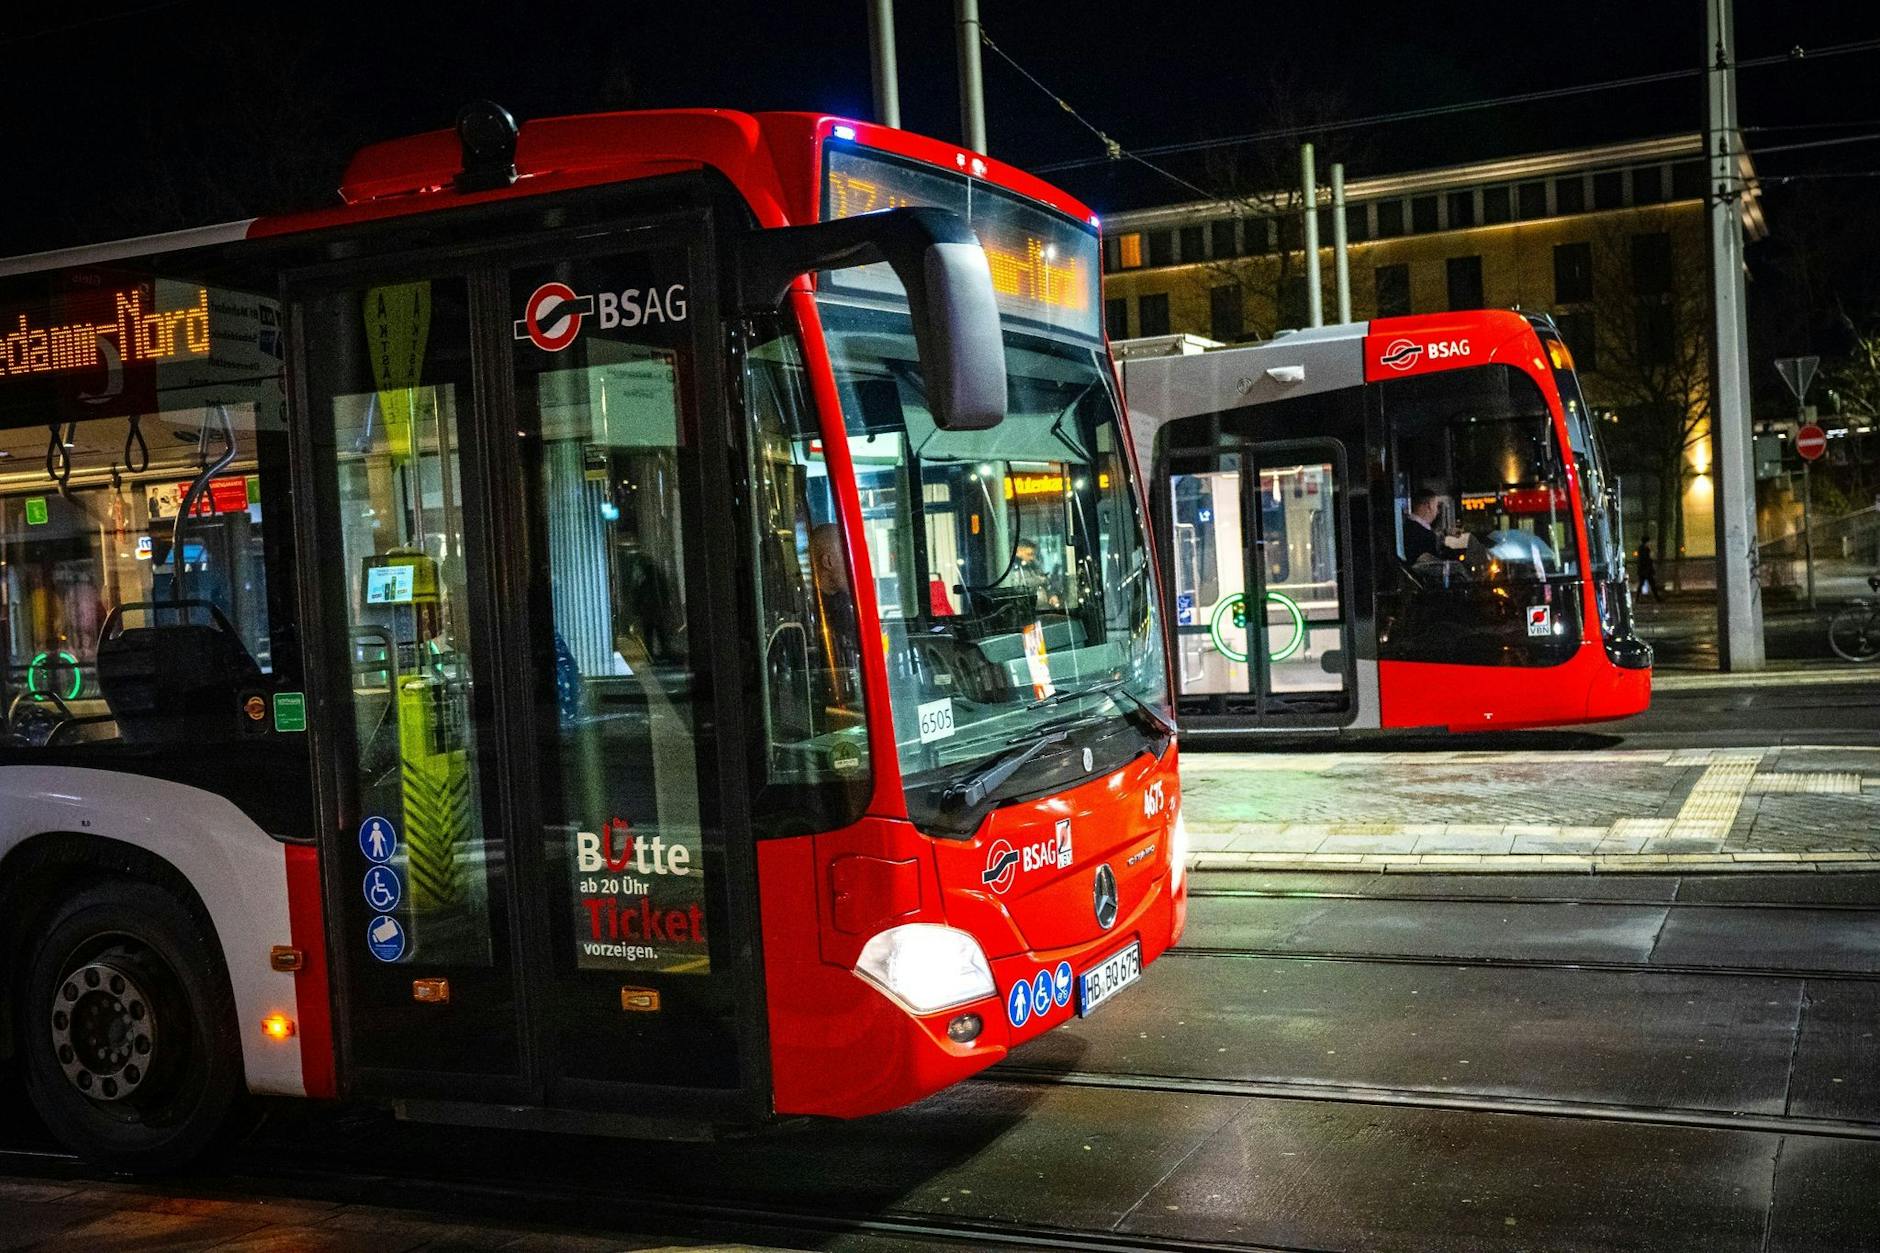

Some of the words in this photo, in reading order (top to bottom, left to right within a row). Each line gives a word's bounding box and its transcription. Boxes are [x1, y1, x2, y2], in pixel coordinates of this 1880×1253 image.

[599, 284, 687, 329] BSAG
[1428, 339, 1471, 360] BSAG
[1530, 625, 1550, 635] VBN
[921, 709, 953, 734] 6505
[1023, 838, 1056, 872] BSAG
[580, 878, 598, 894] ab
[601, 879, 618, 894] 20
[623, 876, 650, 895] Ühr
[582, 896, 704, 944] Ticket
[584, 942, 658, 962] vorzeigen.
[1086, 972, 1101, 1002] HB
[1106, 962, 1119, 992] BQ
[1120, 949, 1139, 982] 675
